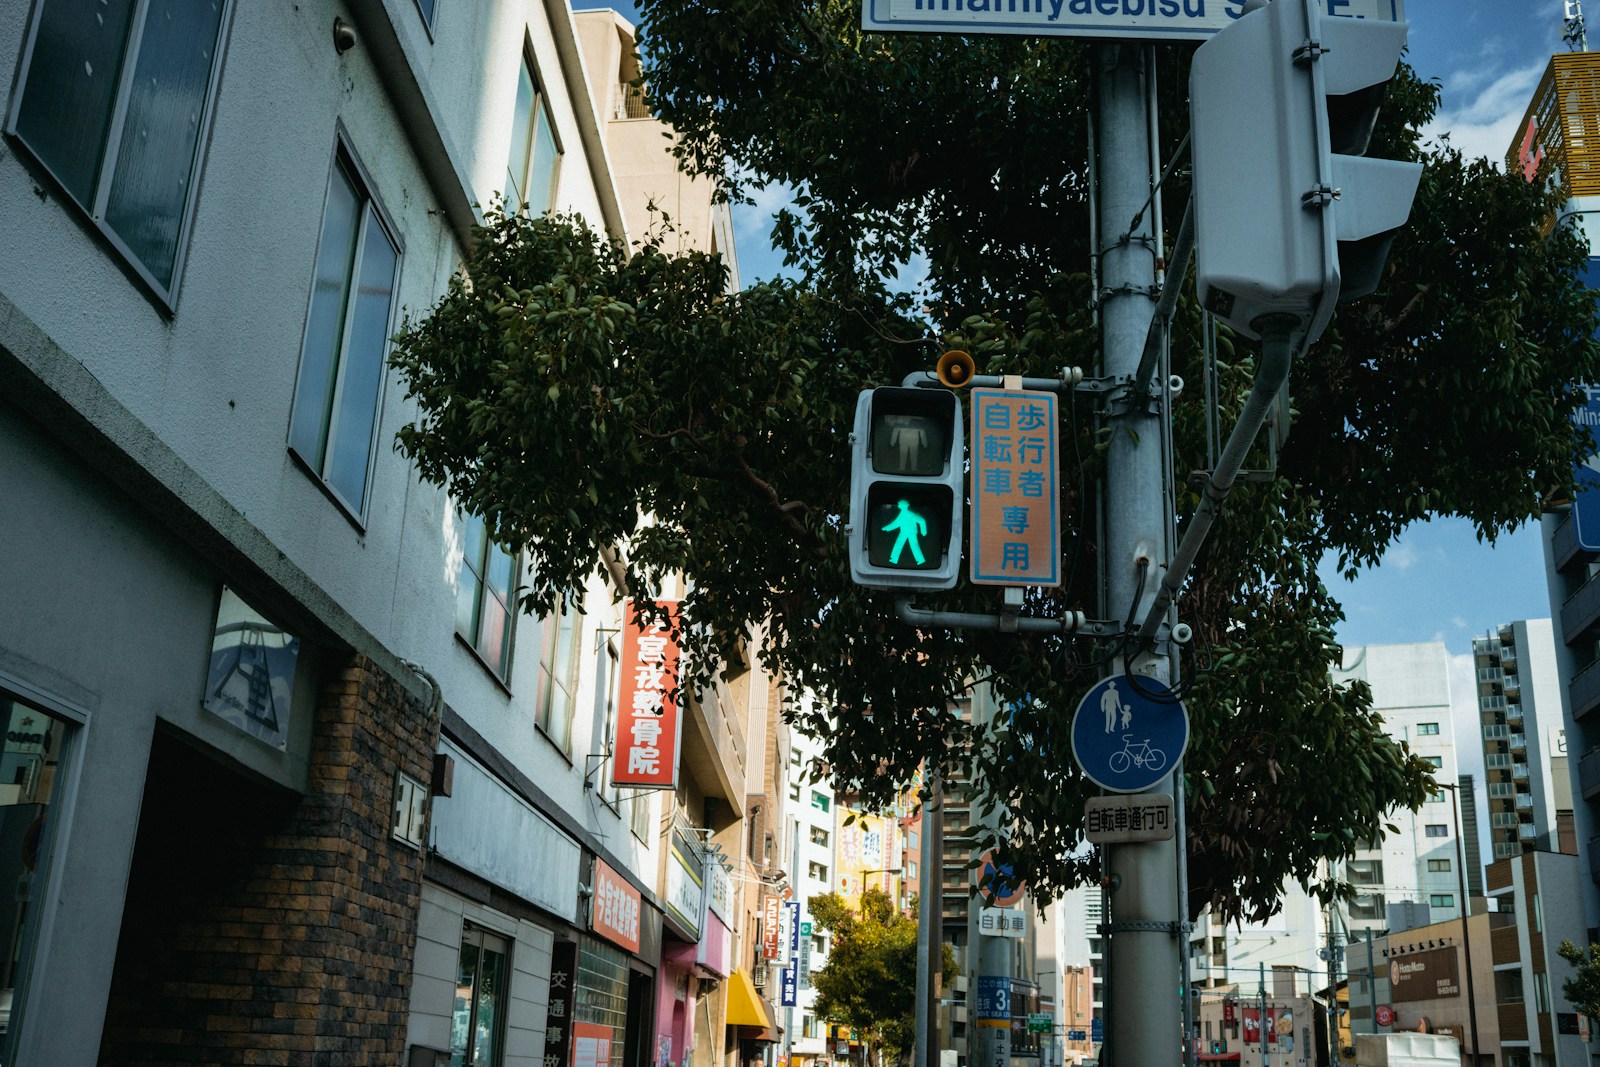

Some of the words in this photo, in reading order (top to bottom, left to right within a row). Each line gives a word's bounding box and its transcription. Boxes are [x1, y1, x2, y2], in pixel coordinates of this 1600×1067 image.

[983, 402, 1013, 496] 自転車
[1571, 407, 1600, 425] Min
[1017, 403, 1046, 497] 歩行者
[1000, 505, 1030, 571] 専用
[1088, 805, 1170, 832] 自転車通行可
[981, 914, 1025, 931] 自動車
[543, 970, 568, 1067] 交通事故
